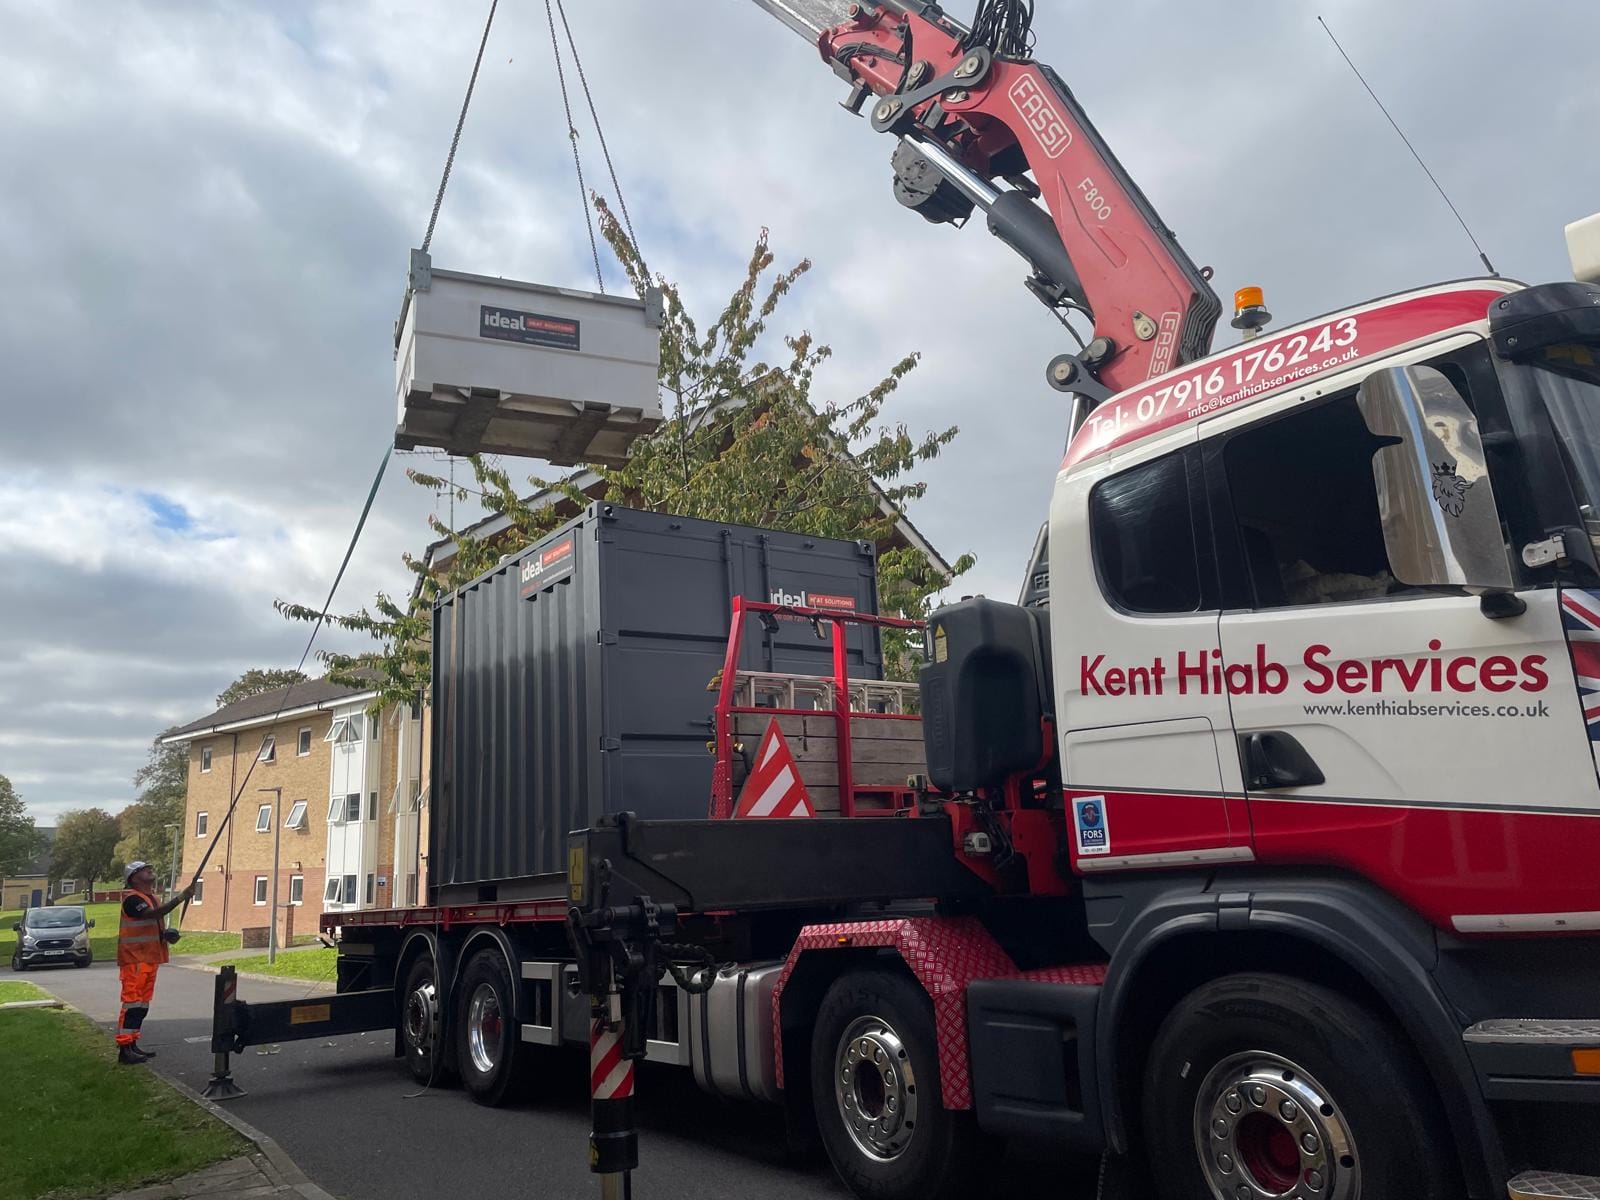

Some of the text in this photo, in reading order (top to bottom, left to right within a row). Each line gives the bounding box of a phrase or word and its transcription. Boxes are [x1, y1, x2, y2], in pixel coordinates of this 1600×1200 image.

[1013, 80, 1067, 152] FASSI
[1077, 177, 1112, 220] F800
[484, 310, 526, 331] ideal
[1089, 317, 1358, 440] Tel: 07916 176243
[1187, 347, 1360, 419] info@kenthiabservices.co.uk
[521, 553, 544, 583] ideal
[770, 588, 808, 608] ideal
[1080, 639, 1549, 696] Kent Hiab Services
[1303, 700, 1550, 717] www.kenthiabservices.co.uk
[1083, 829, 1103, 839] FORS
